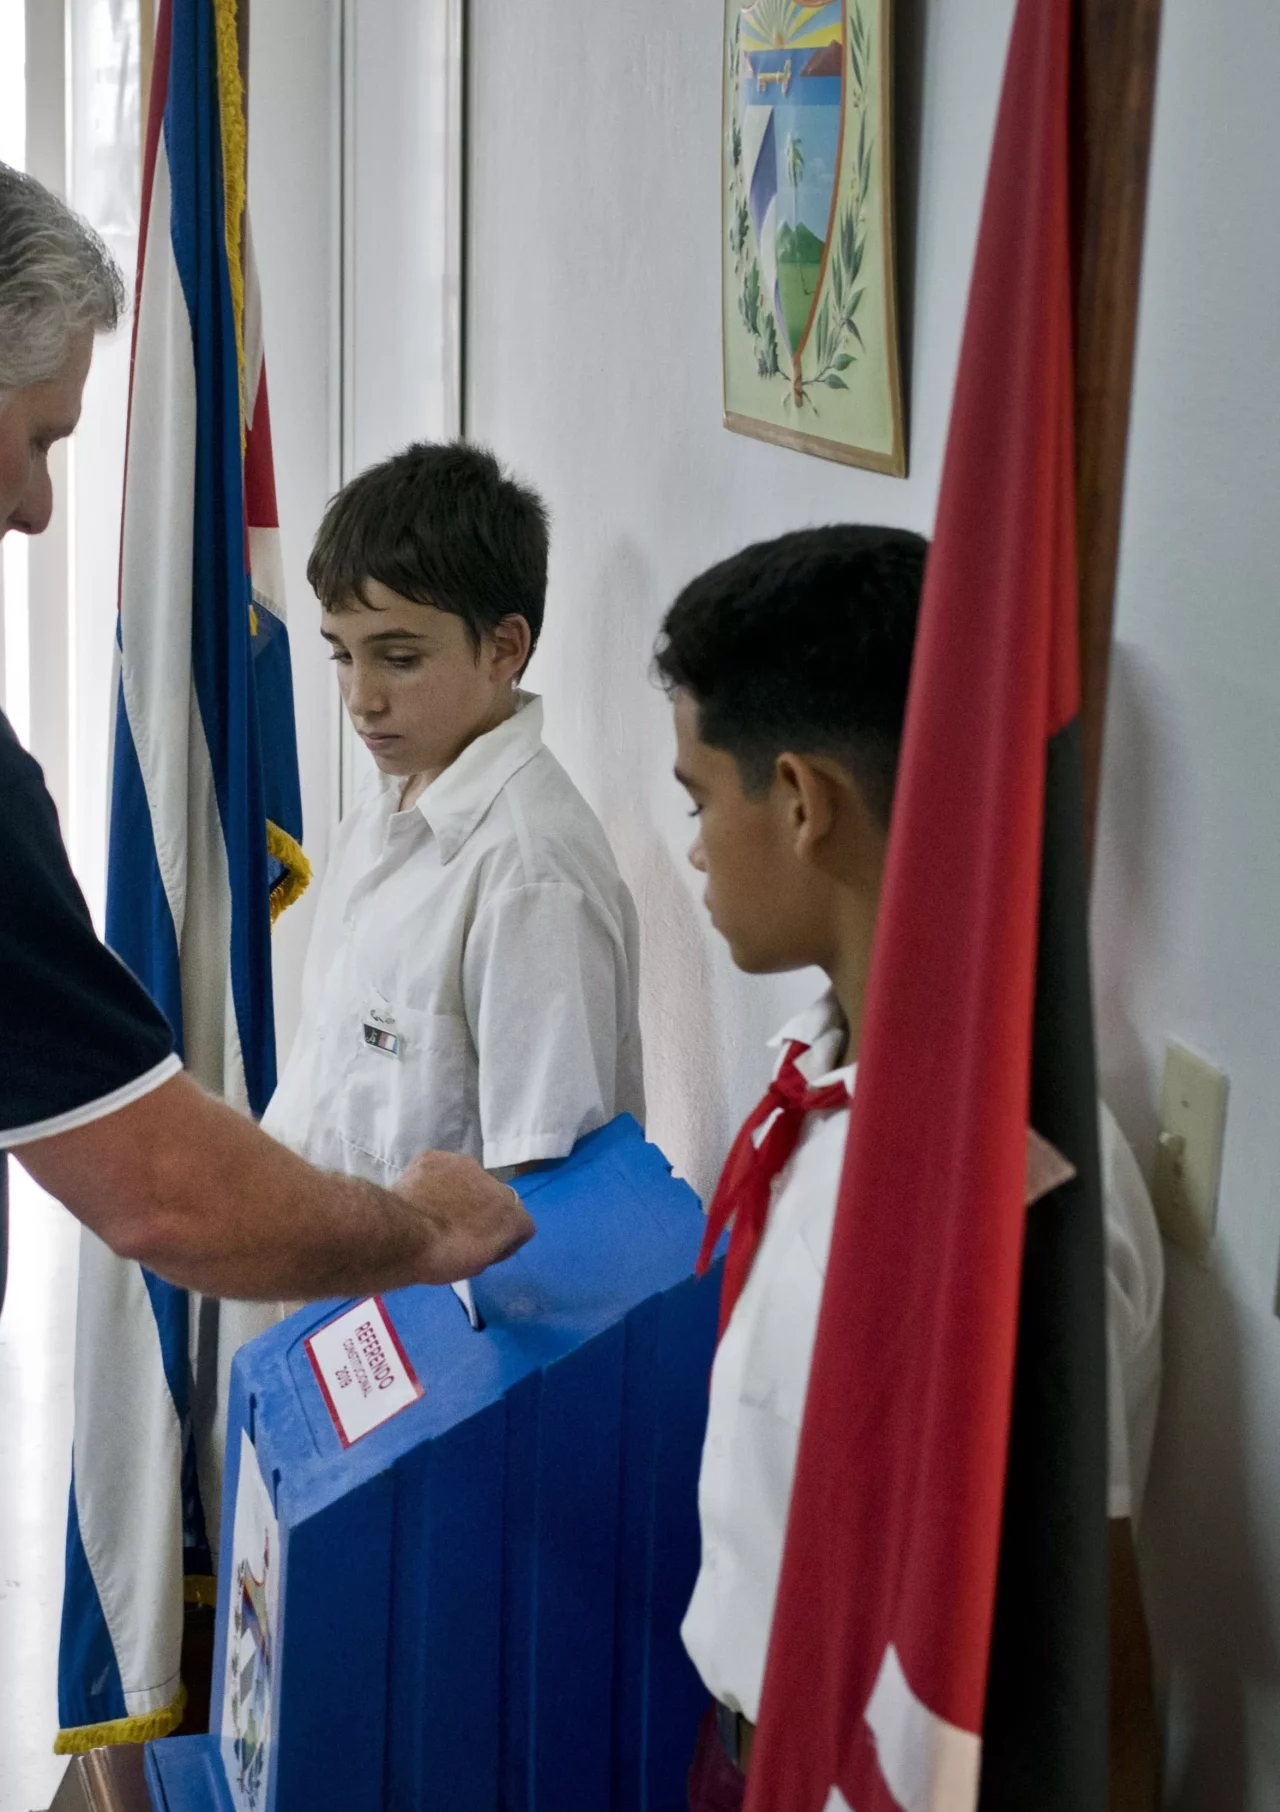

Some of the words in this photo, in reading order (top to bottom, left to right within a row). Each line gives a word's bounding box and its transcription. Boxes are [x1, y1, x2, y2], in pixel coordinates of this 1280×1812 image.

[335, 1365, 352, 1389] 2019
[343, 1338, 372, 1398] CONSTITUCIONAL
[355, 1321, 395, 1390] REFERENDO
